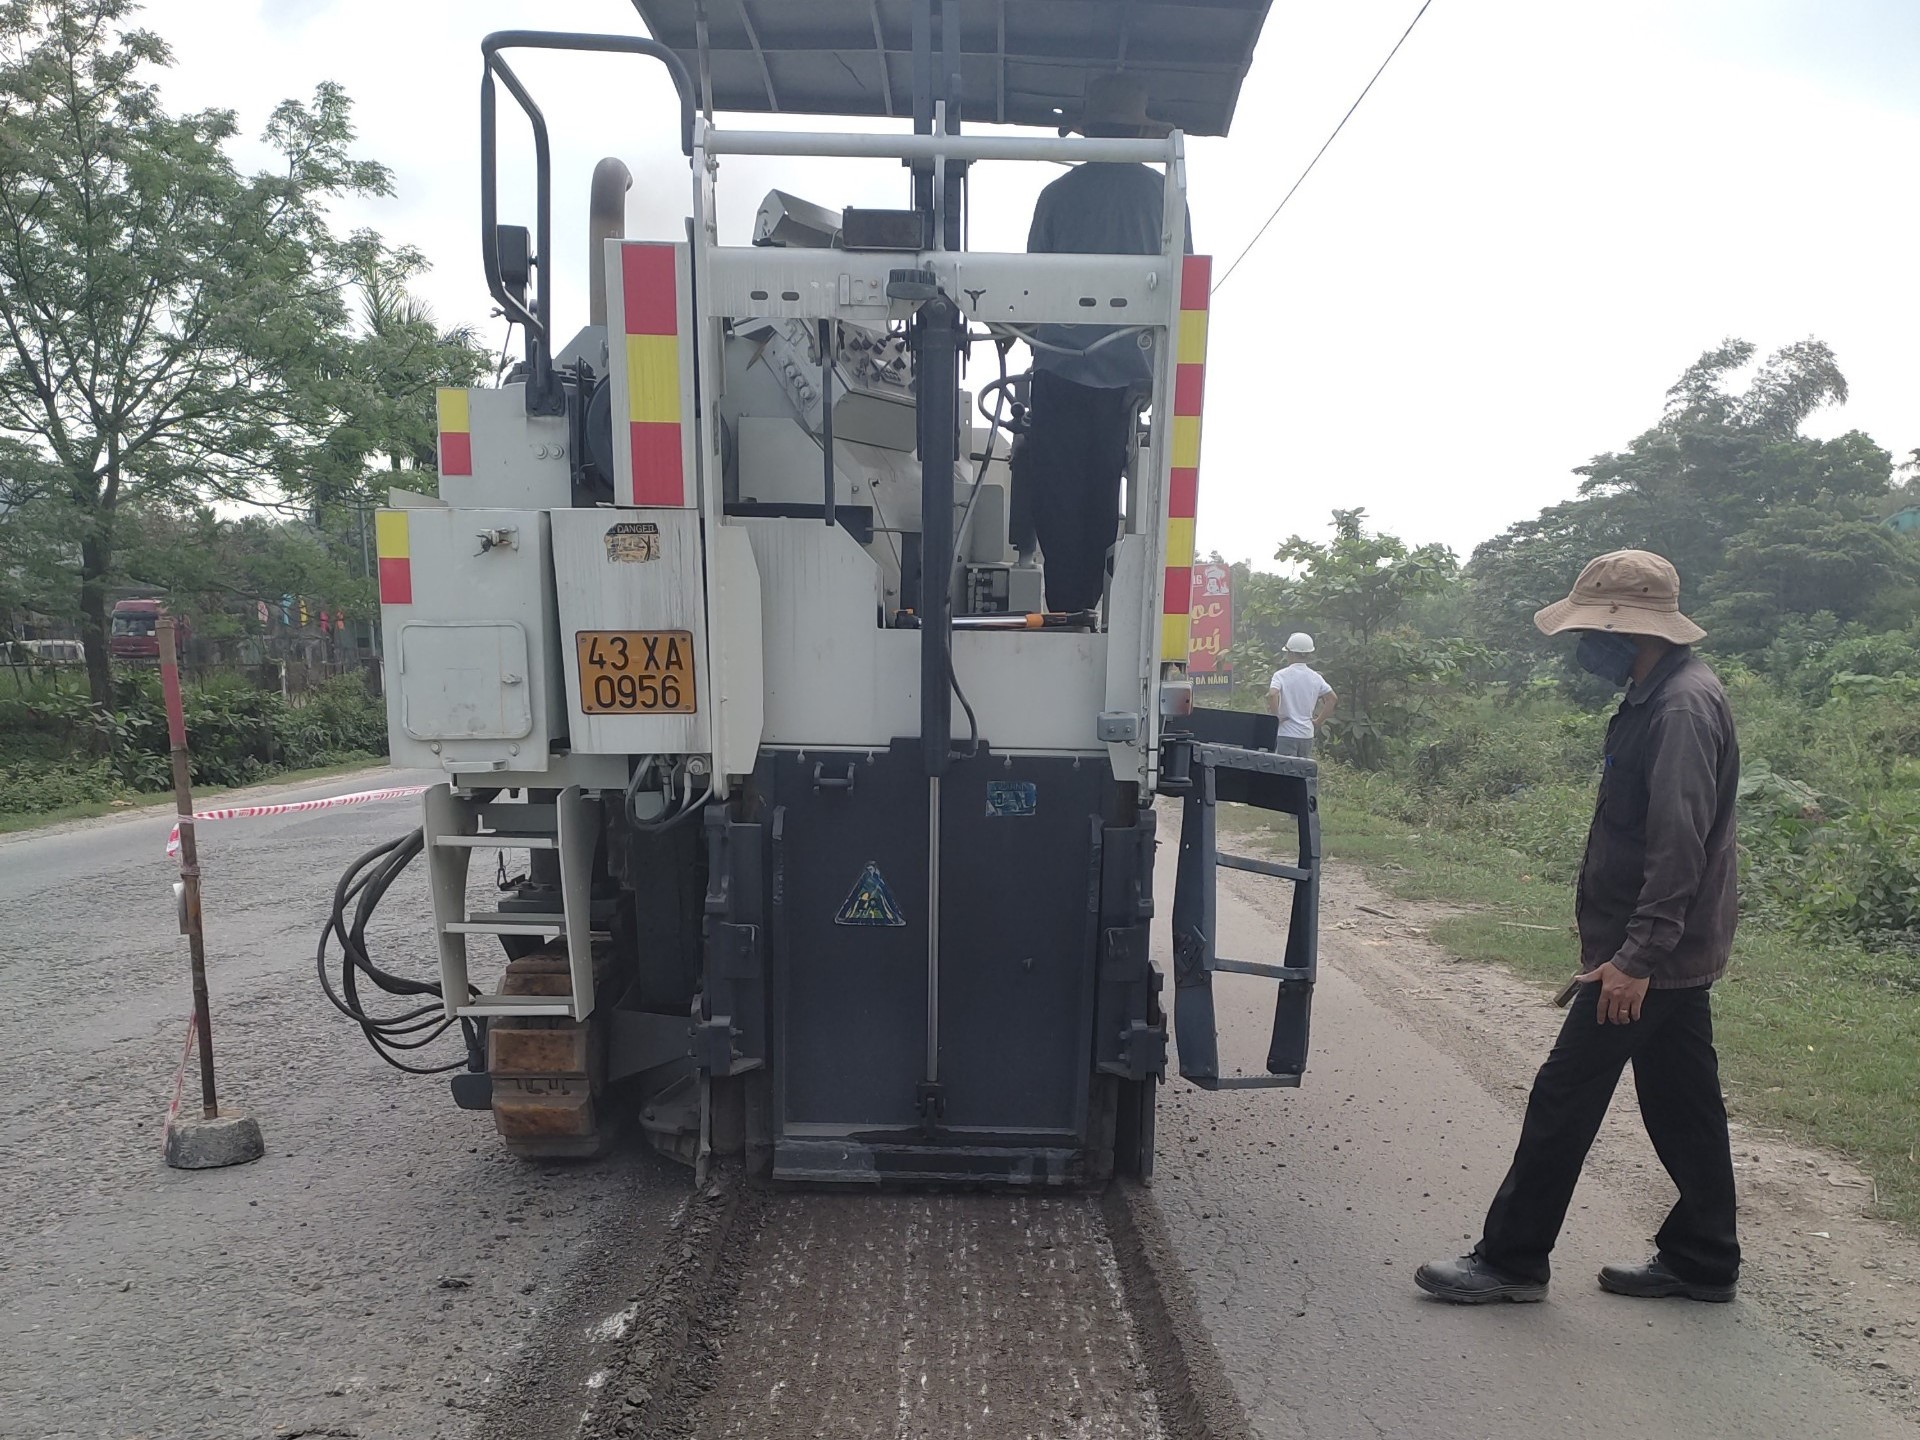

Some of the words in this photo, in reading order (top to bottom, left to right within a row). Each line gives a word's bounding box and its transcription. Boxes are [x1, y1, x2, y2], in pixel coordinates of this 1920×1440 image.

[617, 524, 656, 534] DANGER
[1190, 602, 1224, 625] ọc
[588, 636, 629, 671] 43
[642, 636, 684, 671] XA
[1189, 628, 1221, 656] uý
[594, 674, 681, 709] 0956
